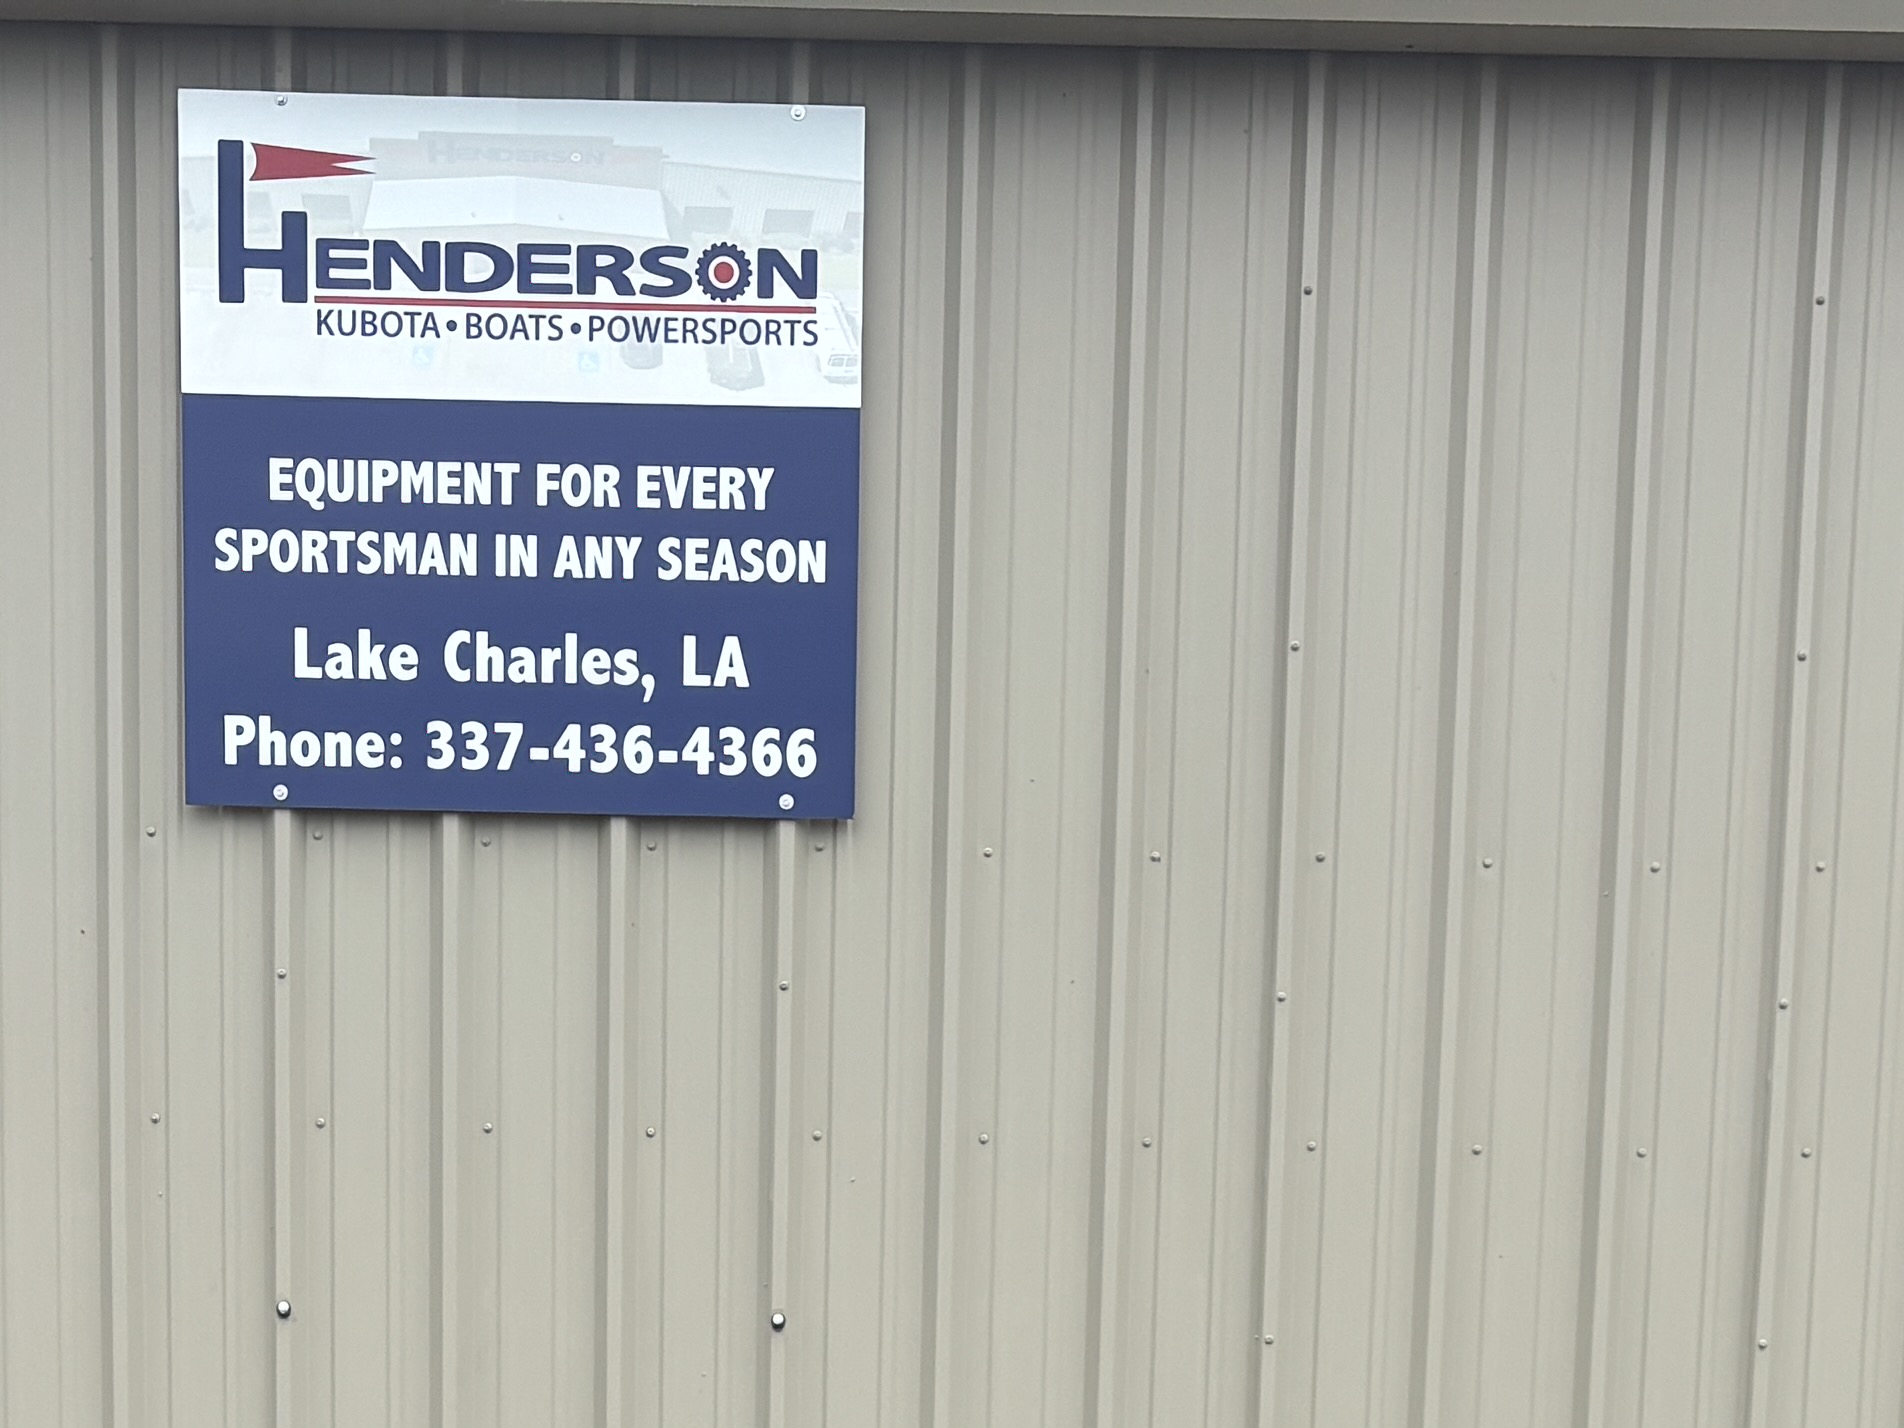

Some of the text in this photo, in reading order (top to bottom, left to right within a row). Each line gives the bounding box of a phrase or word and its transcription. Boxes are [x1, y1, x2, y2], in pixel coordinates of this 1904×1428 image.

[217, 139, 819, 304] HENDERSON
[315, 308, 820, 348] KUBOTA BOATS POWERSPORTS
[268, 456, 775, 512] EQUIPMENT FOR EVERY
[213, 526, 827, 585] SPORTSMAN IN ANY SEASON
[295, 626, 751, 703] Lake Charles, LA
[222, 714, 818, 779] Phone: 337-436-4366
